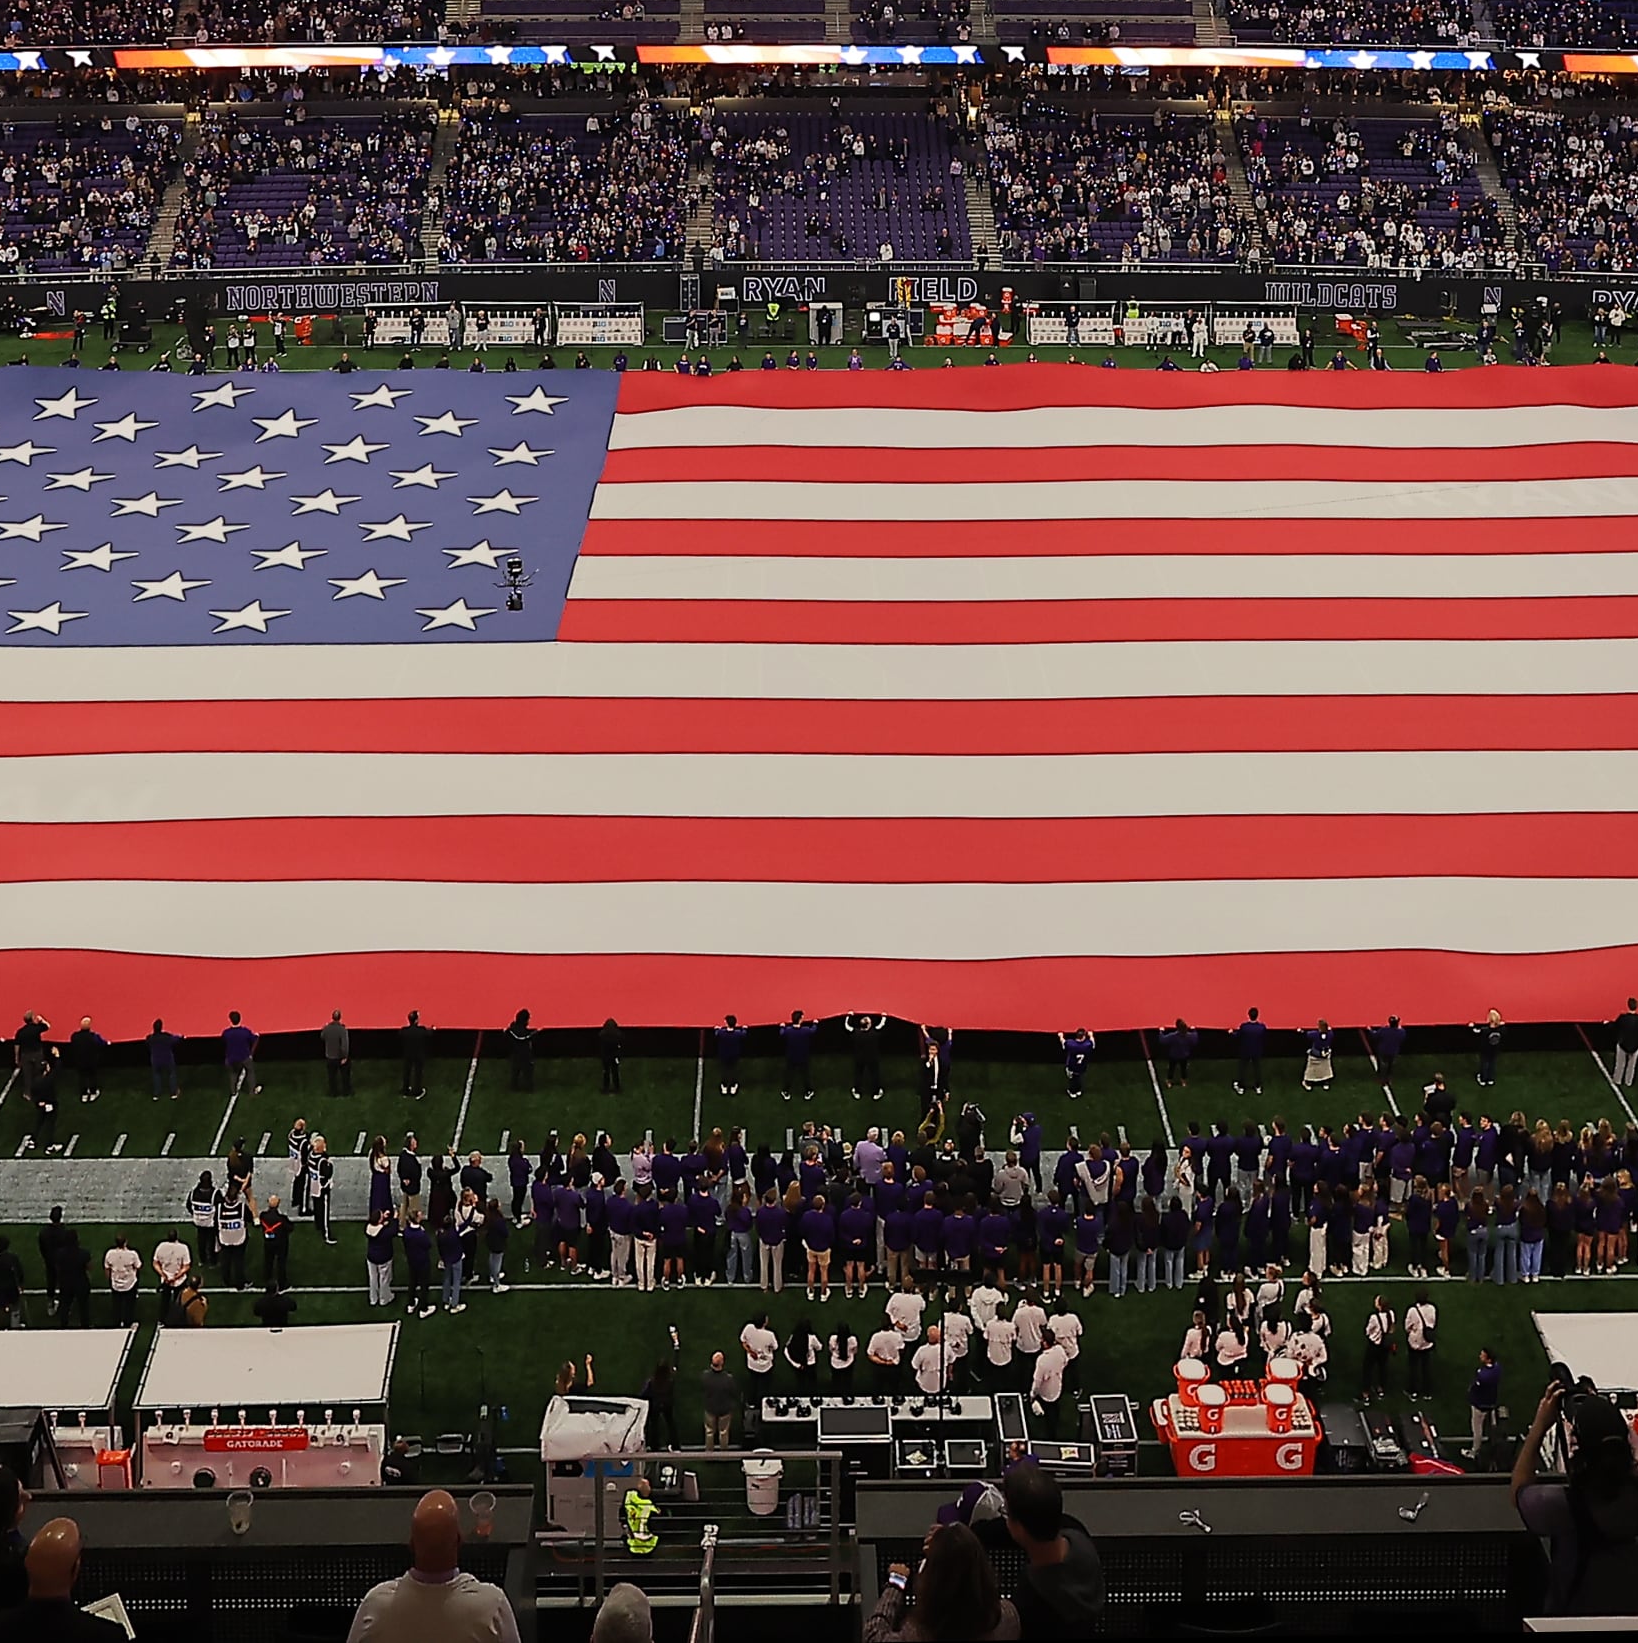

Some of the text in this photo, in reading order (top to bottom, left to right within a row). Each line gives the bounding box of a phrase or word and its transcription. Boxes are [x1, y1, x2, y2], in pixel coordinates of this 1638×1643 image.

[226, 281, 439, 311] NORTHWESTERN
[743, 276, 826, 302] RYAN
[1264, 282, 1397, 309] WILDCATS
[1207, 1408, 1220, 1420] G
[1275, 1408, 1289, 1420] G
[226, 1439, 284, 1449] GATORADE
[1275, 1442, 1303, 1470] G
[1189, 1443, 1216, 1472] G
